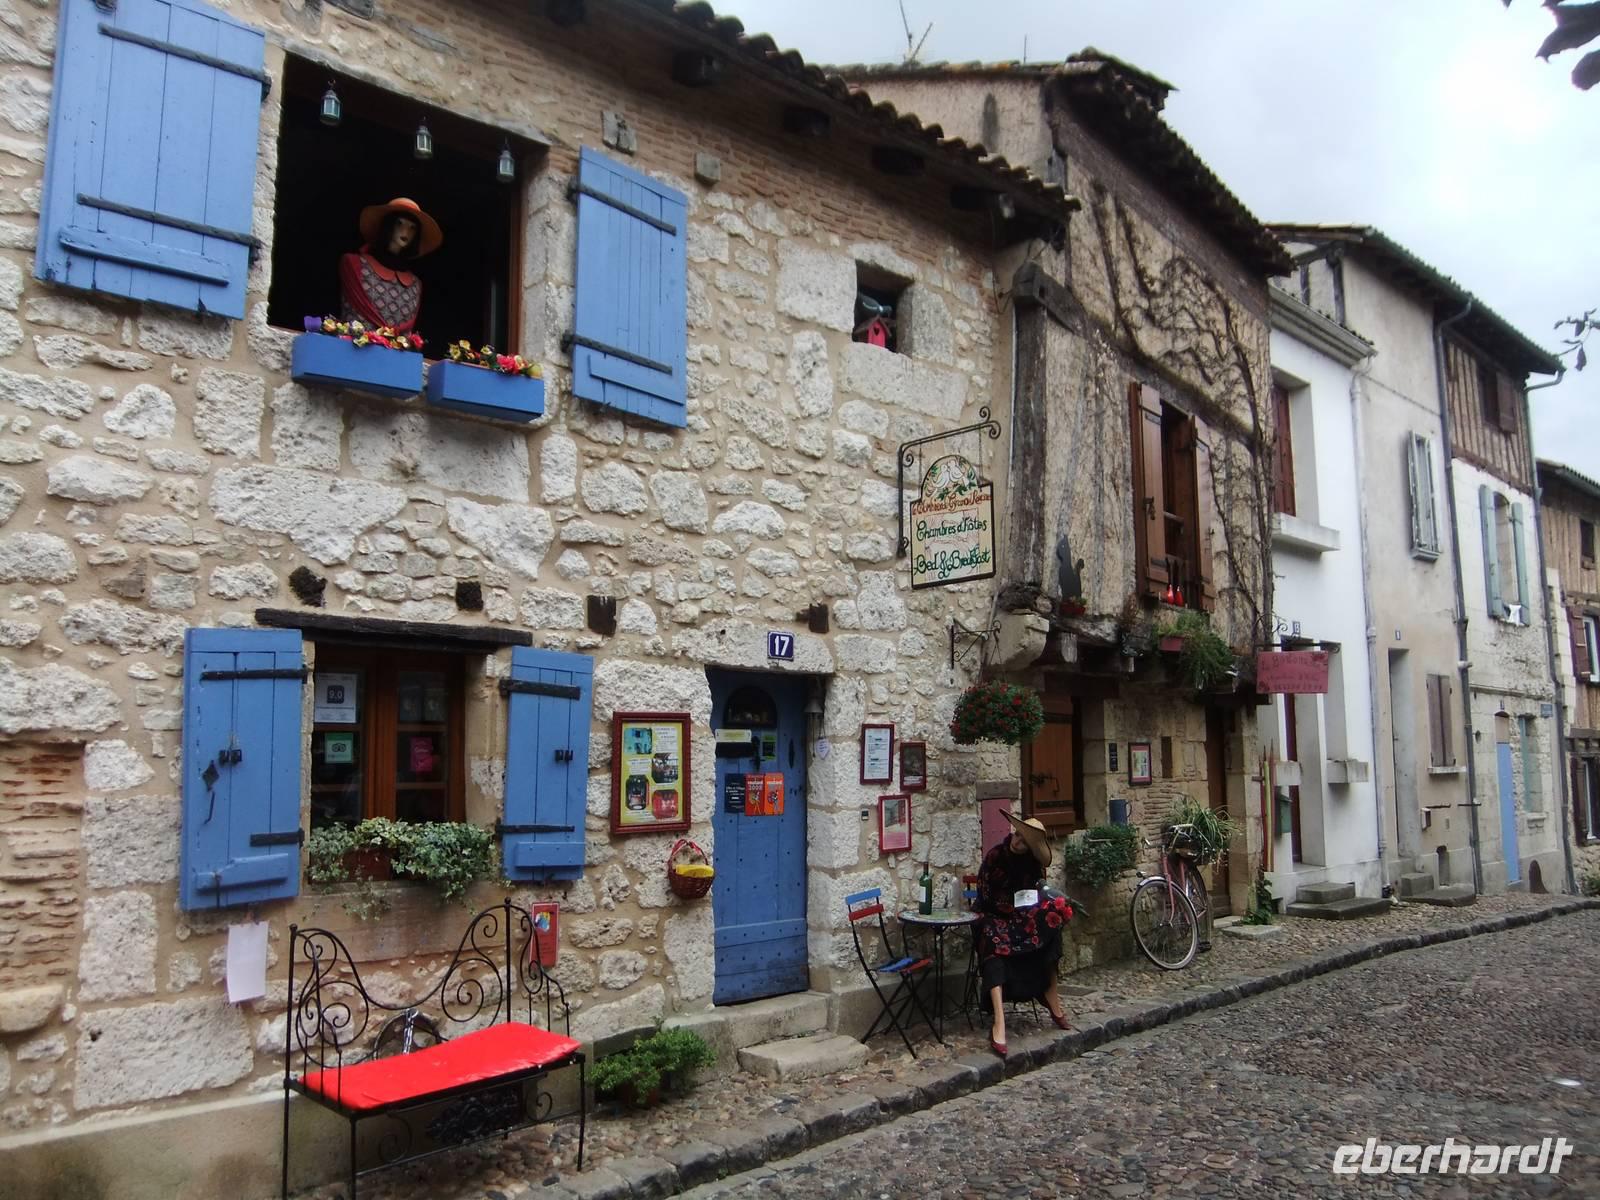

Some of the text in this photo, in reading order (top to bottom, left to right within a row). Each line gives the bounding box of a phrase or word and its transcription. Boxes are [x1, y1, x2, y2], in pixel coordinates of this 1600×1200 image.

[916, 518, 956, 541] Chambres
[913, 552, 940, 576] Bed
[946, 544, 991, 571] Breakfast
[774, 635, 790, 656] 17
